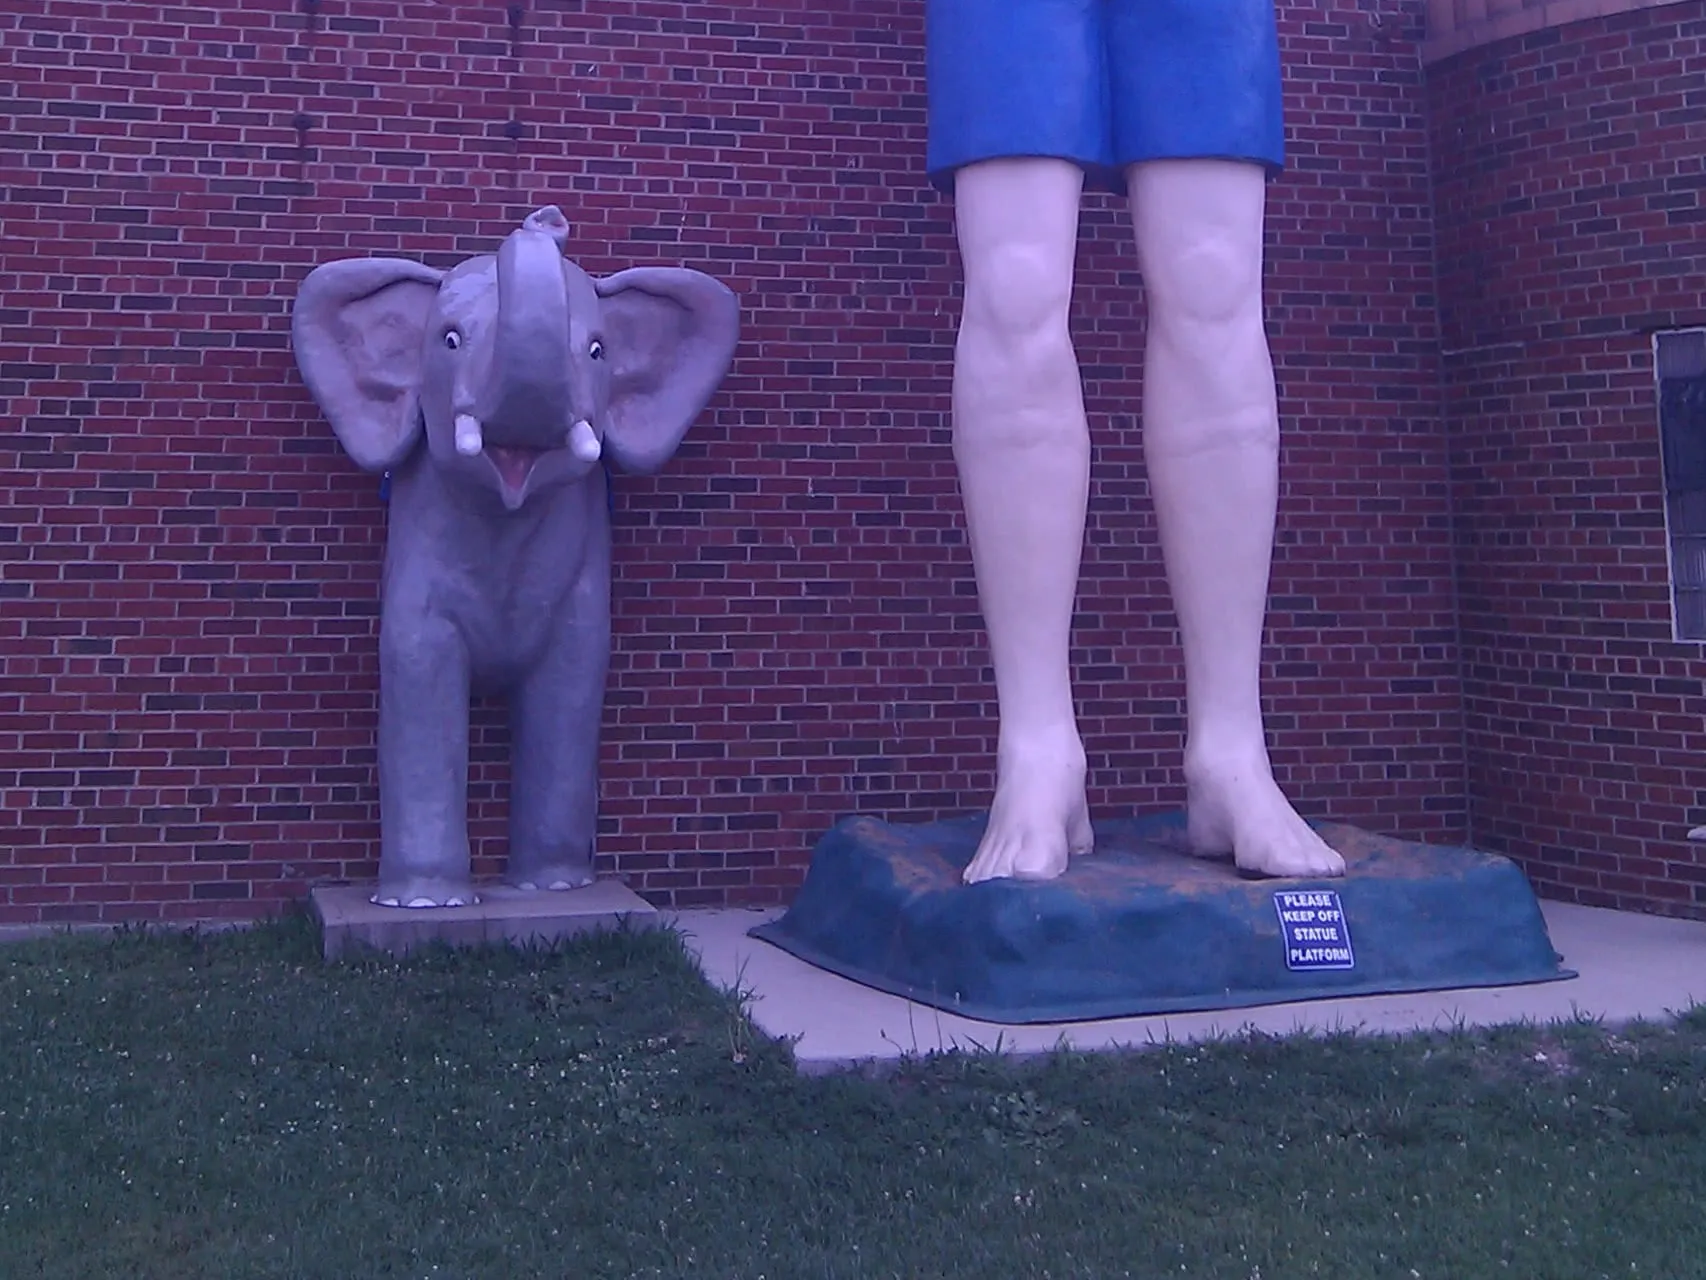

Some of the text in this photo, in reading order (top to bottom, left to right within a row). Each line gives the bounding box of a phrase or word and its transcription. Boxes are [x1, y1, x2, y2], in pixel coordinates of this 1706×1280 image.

[1283, 894, 1332, 907] PLEASE
[1282, 910, 1340, 922] KEEP OFF
[1293, 927, 1338, 941] STATUE
[1290, 948, 1350, 961] PLATFORM
